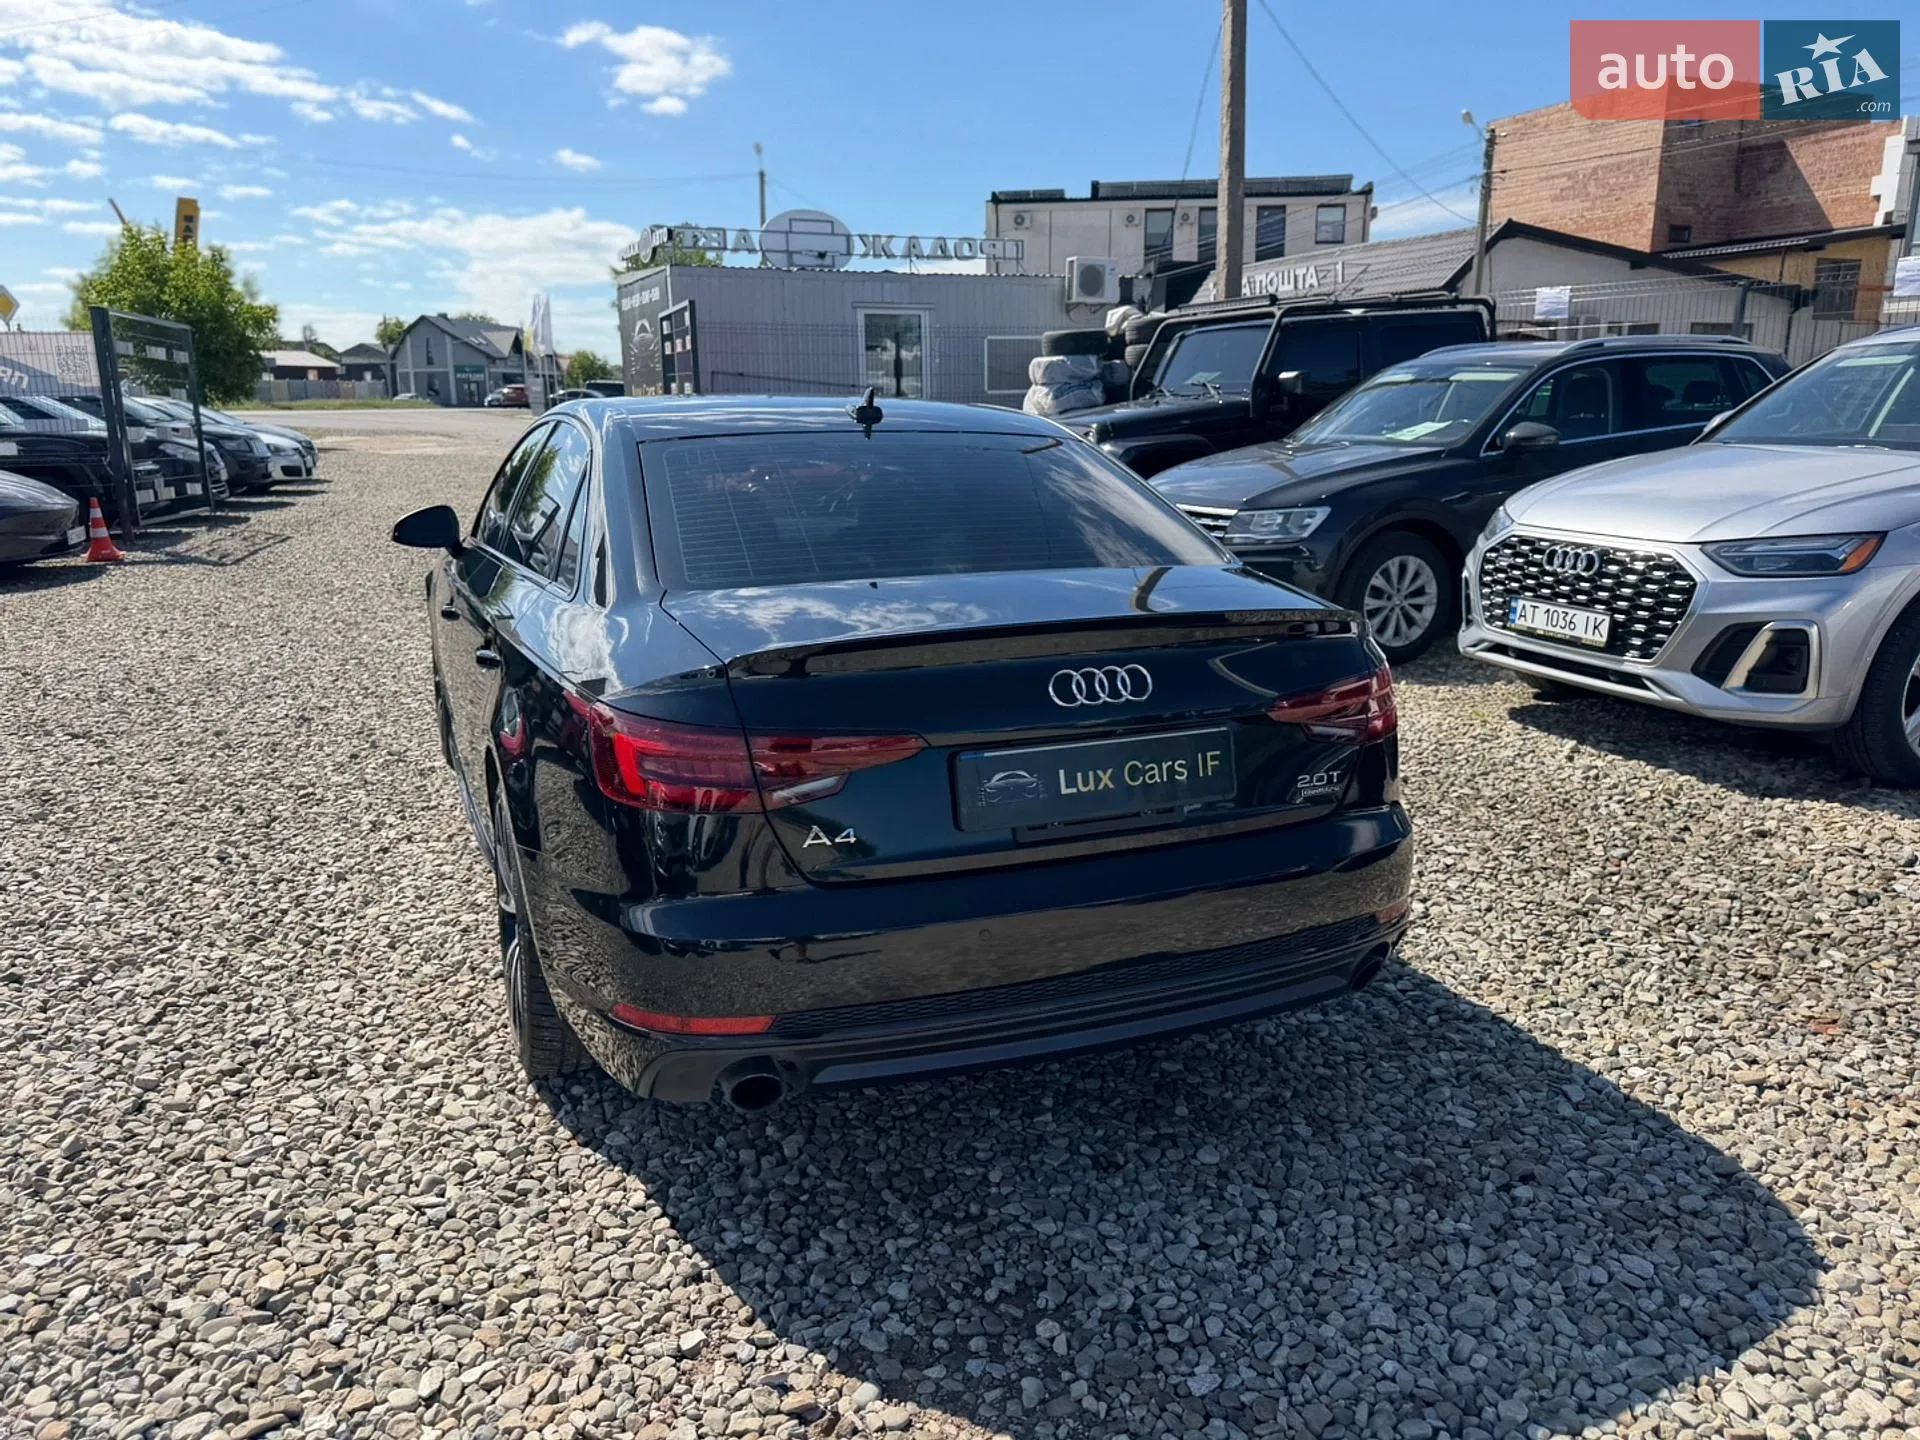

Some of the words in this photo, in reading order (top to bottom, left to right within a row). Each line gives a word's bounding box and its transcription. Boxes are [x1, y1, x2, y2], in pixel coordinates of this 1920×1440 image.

[1255, 265, 1319, 296] ПОШТА
[1518, 602, 1540, 624] AT
[1544, 607, 1577, 632] 1036
[1583, 615, 1606, 638] IK
[1058, 767, 1115, 795] Lux
[1124, 758, 1188, 787] Cars
[1197, 750, 1222, 777] IF
[802, 825, 857, 848] A4
